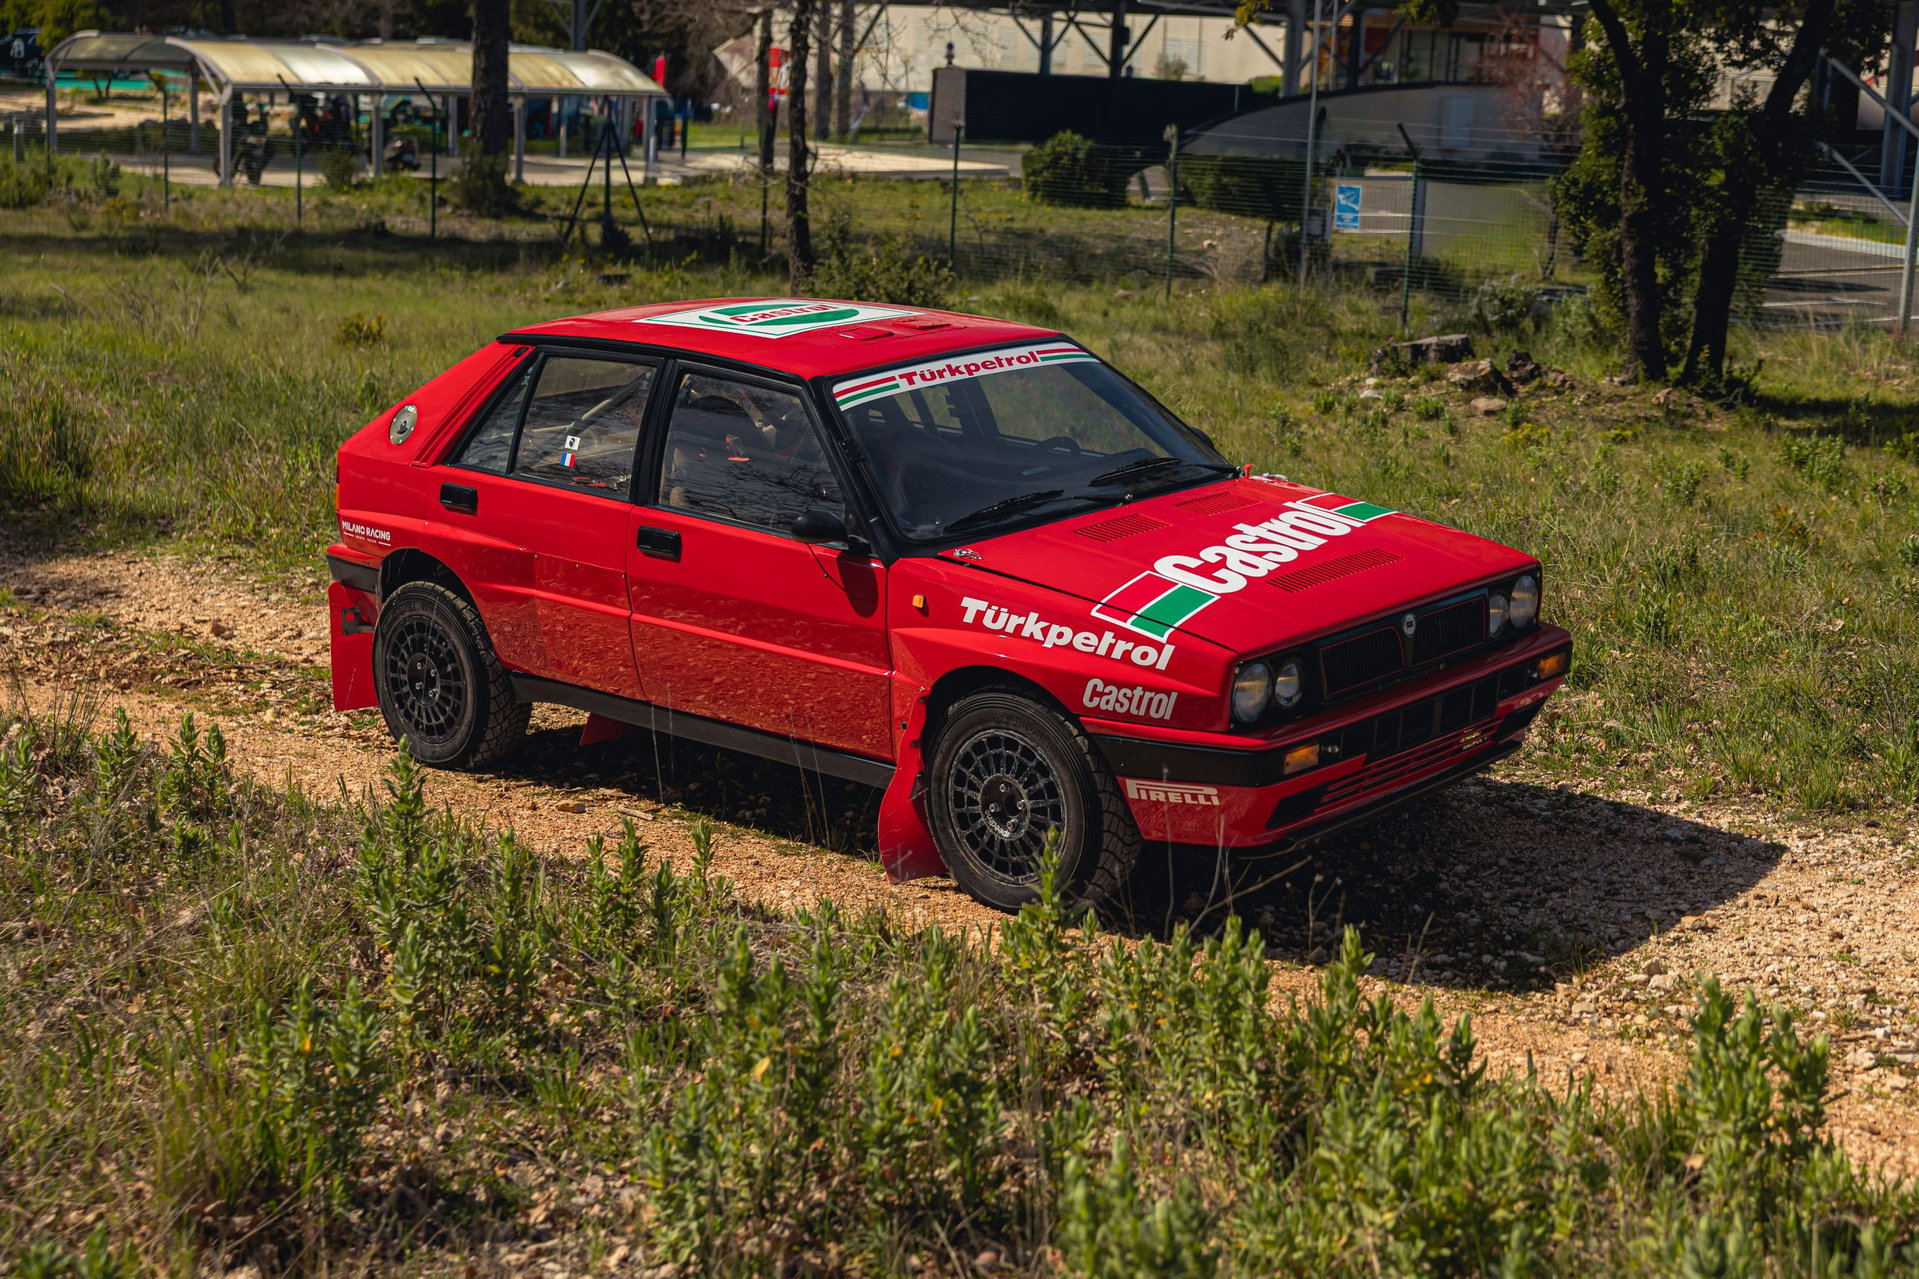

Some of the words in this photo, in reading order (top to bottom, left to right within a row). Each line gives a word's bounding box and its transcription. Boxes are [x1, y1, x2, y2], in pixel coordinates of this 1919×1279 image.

[730, 304, 838, 322] Castrol
[899, 351, 1040, 386] Türkpetrol
[342, 520, 365, 535] MILANO
[366, 527, 391, 541] RACING
[1153, 500, 1367, 594] Castrol
[960, 597, 1175, 671] Türkpetrol
[1082, 678, 1178, 720] Castrol
[1125, 779, 1220, 806] PIRELLI
